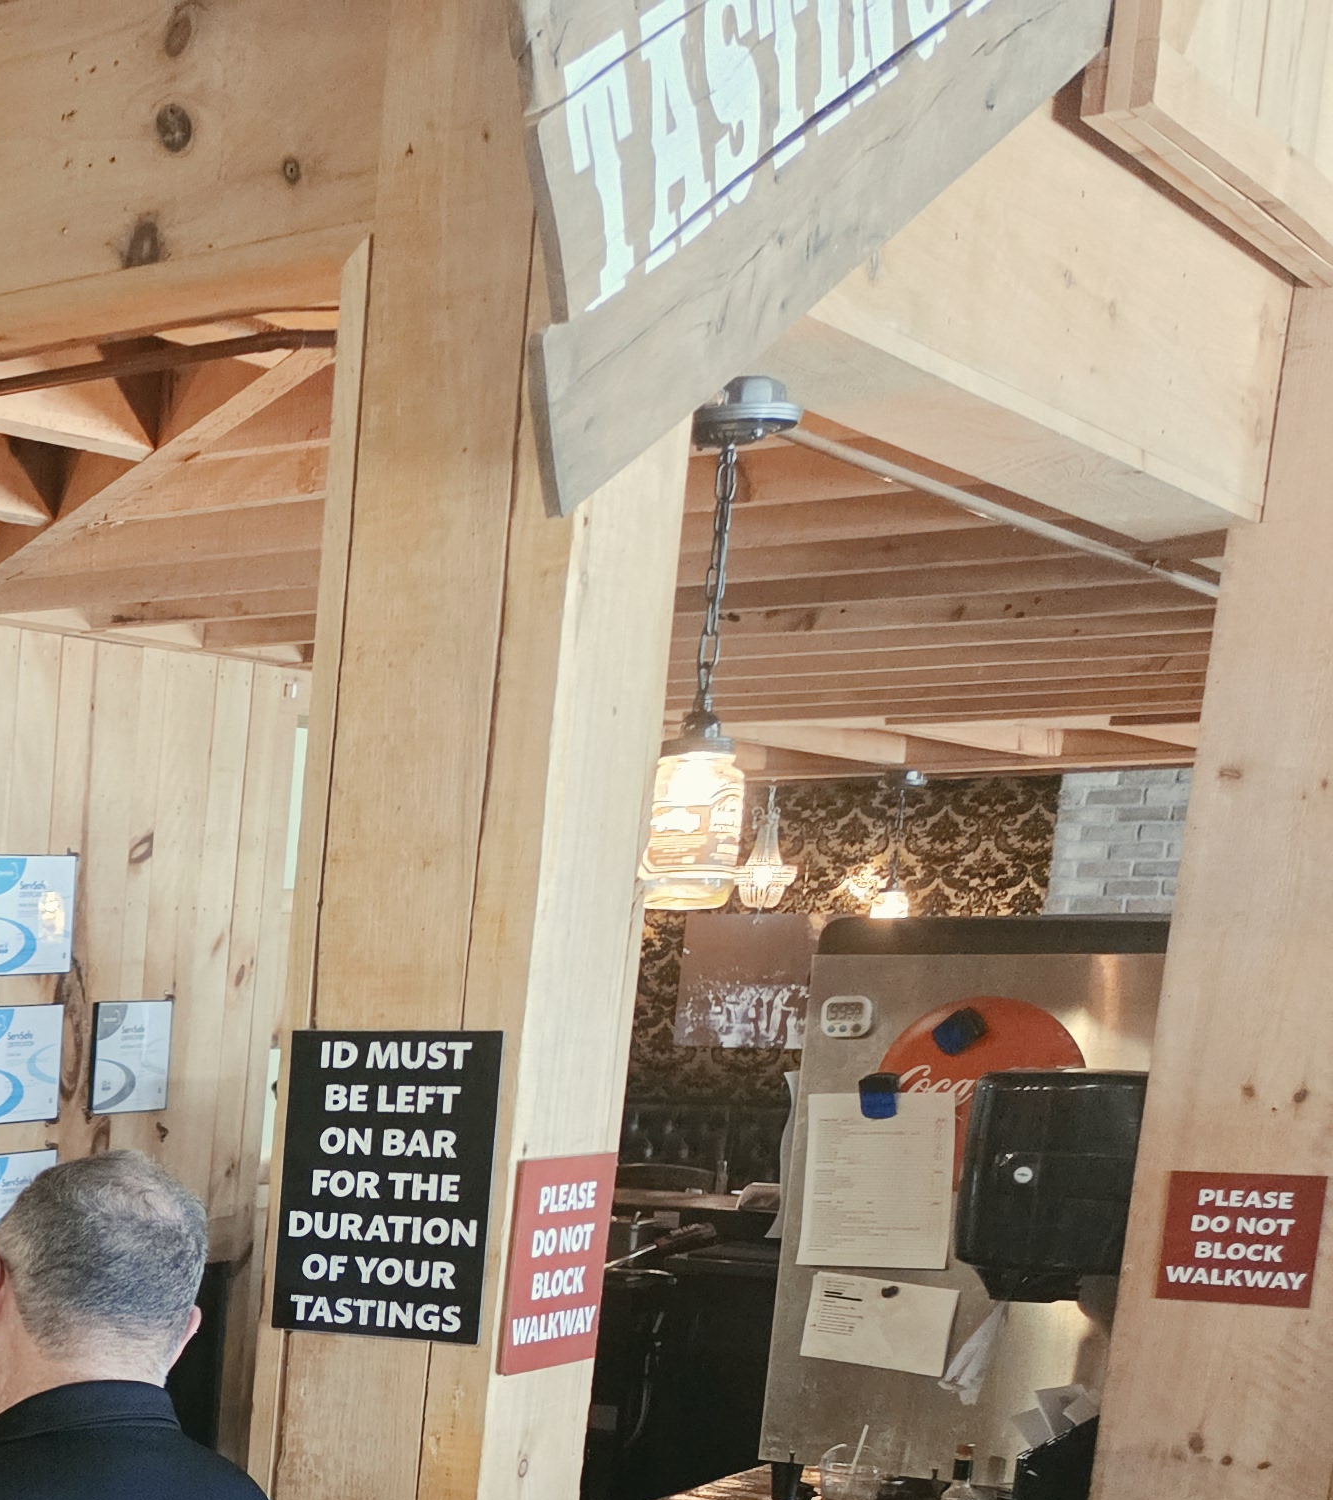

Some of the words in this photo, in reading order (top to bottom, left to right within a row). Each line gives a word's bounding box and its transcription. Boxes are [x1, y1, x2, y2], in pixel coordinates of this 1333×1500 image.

[320, 1041, 359, 1070] ID
[365, 1040, 473, 1071] MUST
[324, 1084, 372, 1113] BE
[376, 1085, 462, 1115] LEFT
[319, 1127, 372, 1156] ON
[381, 1128, 457, 1159] BAR
[311, 1168, 380, 1199] FOR
[386, 1171, 461, 1203] THE
[538, 1181, 598, 1214] PLEASE
[1198, 1188, 1295, 1211] PLEASE
[287, 1210, 478, 1248] DURATION
[531, 1228, 559, 1259] DO
[558, 1223, 595, 1254] NOT
[1191, 1214, 1230, 1236] DO
[1235, 1216, 1296, 1238] NOT
[1193, 1240, 1284, 1264] BLOCK
[301, 1253, 347, 1282] OF
[354, 1256, 456, 1290] YOUR
[530, 1266, 587, 1301] BLOCK
[1165, 1264, 1308, 1292] WALKWAY
[289, 1293, 462, 1334] TASTINGS
[512, 1305, 597, 1347] WALKWAY
